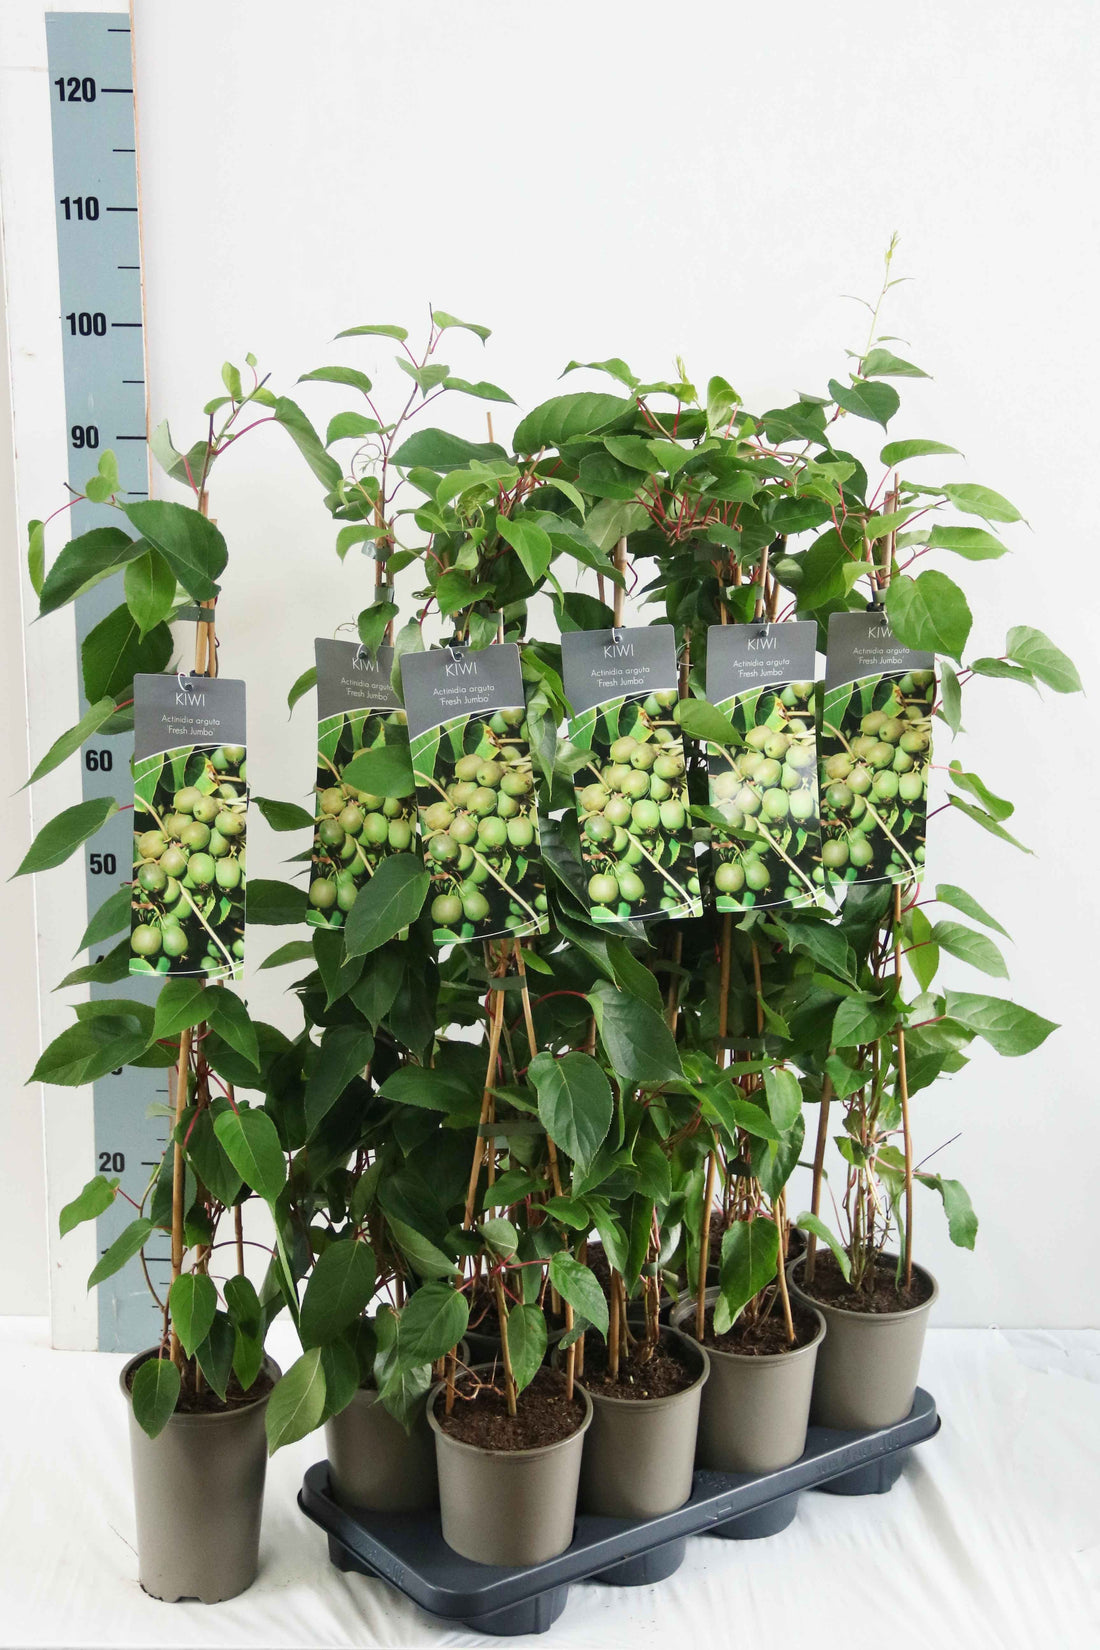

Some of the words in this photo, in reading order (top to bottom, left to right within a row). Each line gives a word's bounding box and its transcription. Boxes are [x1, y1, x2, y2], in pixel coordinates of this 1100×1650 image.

[54, 77, 96, 103] 120
[60, 196, 100, 221] 110
[66, 312, 107, 336] 100
[71, 425, 100, 449] 90
[868, 626, 893, 639] KIW
[603, 643, 634, 659] KIWI
[747, 637, 777, 651] KIWI
[853, 647, 884, 655] Actinidia
[886, 647, 910, 656] arguta
[352, 657, 379, 672] KIWI
[445, 661, 478, 677] KIWI
[733, 658, 764, 668] Actinidia
[766, 658, 790, 667] arguta
[591, 667, 623, 677] Actinidia
[625, 666, 650, 675] arguta
[340, 677, 370, 688] Actinidia
[432, 685, 467, 696] Actinidia
[469, 684, 495, 693] arguta
[175, 692, 205, 707] KIWI
[161, 714, 193, 724] Actinidia
[195, 718, 220, 727] arguta
[85, 749, 113, 772] 60
[89, 853, 117, 875] 50
[98, 1151, 125, 1173] 20
